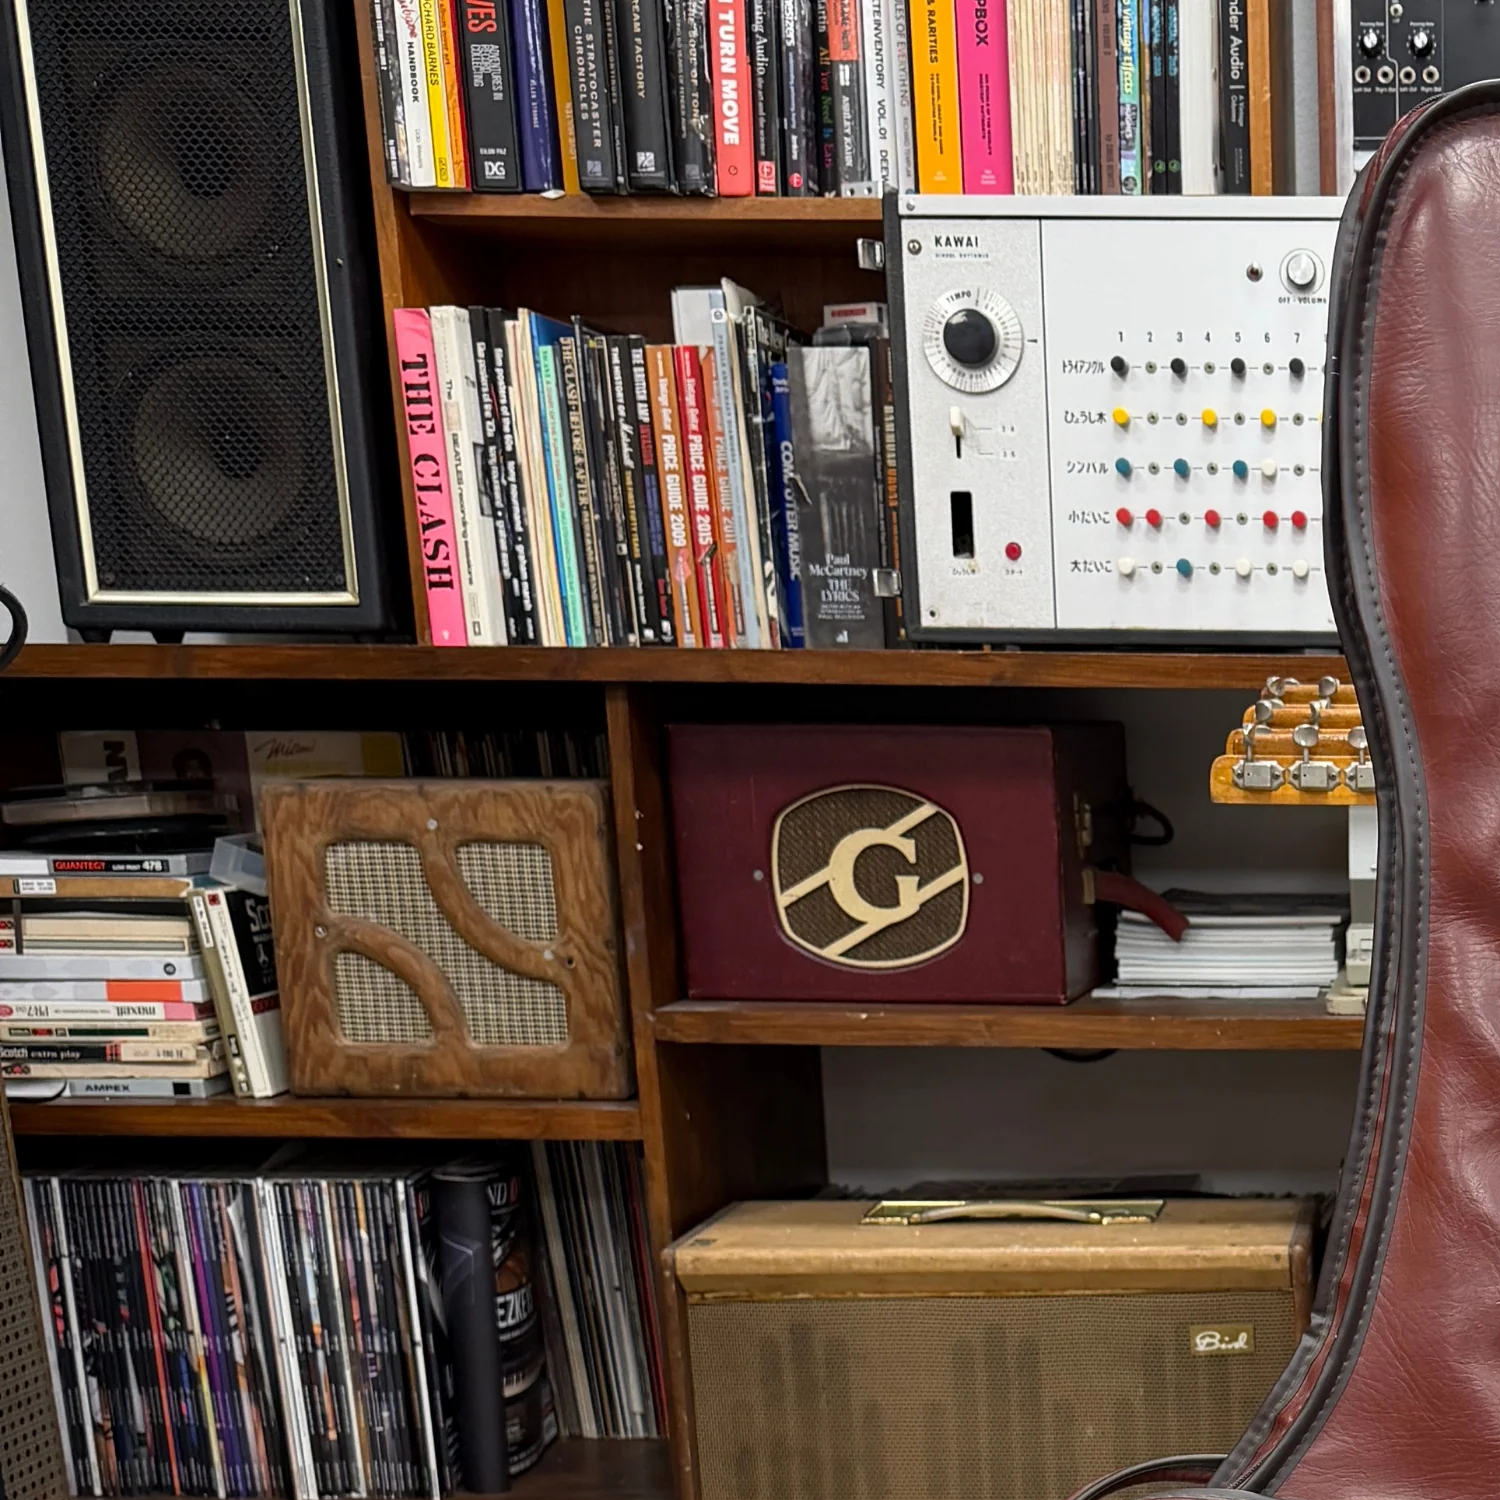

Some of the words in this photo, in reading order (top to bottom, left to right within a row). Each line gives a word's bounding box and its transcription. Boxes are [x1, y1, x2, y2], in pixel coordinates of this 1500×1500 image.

[583, 0, 593, 26] THE
[718, 9, 737, 74] TURN
[873, 18, 885, 90] INVENTORY
[926, 9, 940, 64] RARITIES
[406, 41, 420, 103] HANDBOOK
[427, 42, 440, 86] BARNES
[470, 44, 484, 88] COLLECTING
[480, 44, 492, 74] RECORD
[490, 44, 504, 91] ADVENTURES
[574, 25, 588, 121] CHRONICLES
[634, 37, 646, 99] FACTORY
[754, 33, 769, 78] Audio
[819, 46, 831, 66] All
[1230, 35, 1244, 80] Audio
[585, 33, 602, 148] STRATOCASTER
[897, 41, 911, 108] EVERYTHING
[721, 78, 740, 146] MOVE
[821, 96, 833, 124] Need
[934, 235, 980, 248] KAWAI
[560, 338, 574, 364] THE
[610, 346, 621, 364] THE
[630, 347, 644, 365] THE
[1062, 359, 1105, 374] トライアングル
[400, 353, 437, 436] THE
[445, 379, 454, 400] The
[563, 364, 578, 406] CLASH
[613, 365, 625, 404] HISTORY
[633, 366, 648, 401] BRITISH
[502, 417, 513, 433] the
[617, 404, 627, 418] OF
[637, 402, 651, 424] AMP
[1064, 410, 1107, 424] ひょうし木
[569, 411, 583, 455] BEFORE
[452, 432, 465, 486] BEATLES
[661, 434, 679, 472] PRICE
[688, 434, 706, 472] PRICE
[714, 435, 731, 474] PRICE
[1066, 461, 1109, 474] シンバル
[575, 466, 589, 507] AFTER
[666, 474, 683, 511] GUIDE
[692, 474, 709, 511] GUIDE
[717, 476, 734, 514] GUIDE
[413, 453, 454, 591] CLASH
[456, 486, 470, 540] recording
[669, 513, 688, 547] 2009
[695, 513, 713, 546] 2015
[1068, 510, 1111, 524] 小だいこ
[462, 540, 475, 586] sessions
[515, 543, 528, 581] graham
[785, 530, 802, 581] MUSIC
[808, 563, 868, 580] McCartney
[1070, 559, 1113, 573] 大だいこ
[521, 581, 533, 612] marsh
[820, 590, 860, 602] LYRICS
[55, 861, 106, 870] QUANTEGY
[142, 860, 163, 871] 478
[829, 827, 921, 925] G
[116, 1002, 156, 1017] maxell
[30, 1050, 57, 1058] extra
[60, 1049, 82, 1060] play
[84, 1084, 131, 1092] AMPEX
[1195, 1331, 1249, 1351] Bird
